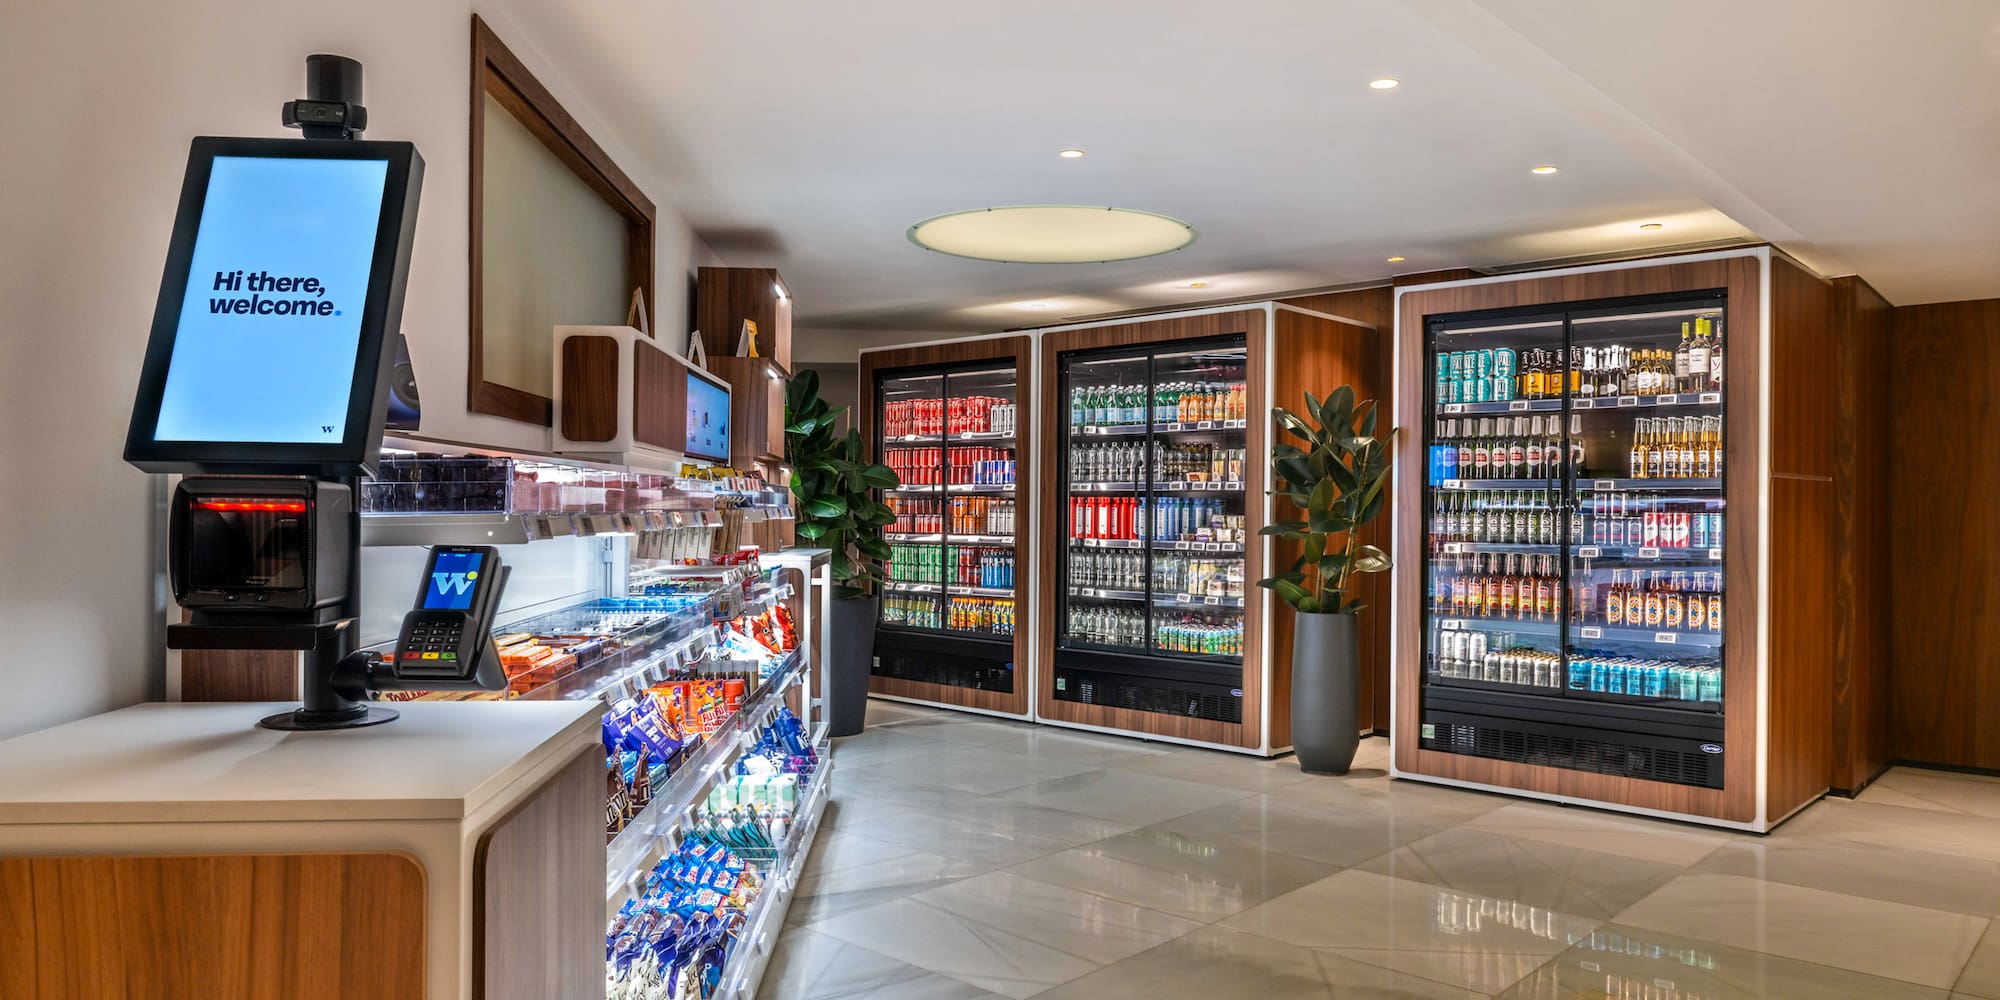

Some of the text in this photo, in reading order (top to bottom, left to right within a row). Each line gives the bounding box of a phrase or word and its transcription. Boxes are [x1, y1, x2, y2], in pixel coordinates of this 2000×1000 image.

[213, 270, 326, 297] Hi there,
[209, 294, 342, 316] welcome.
